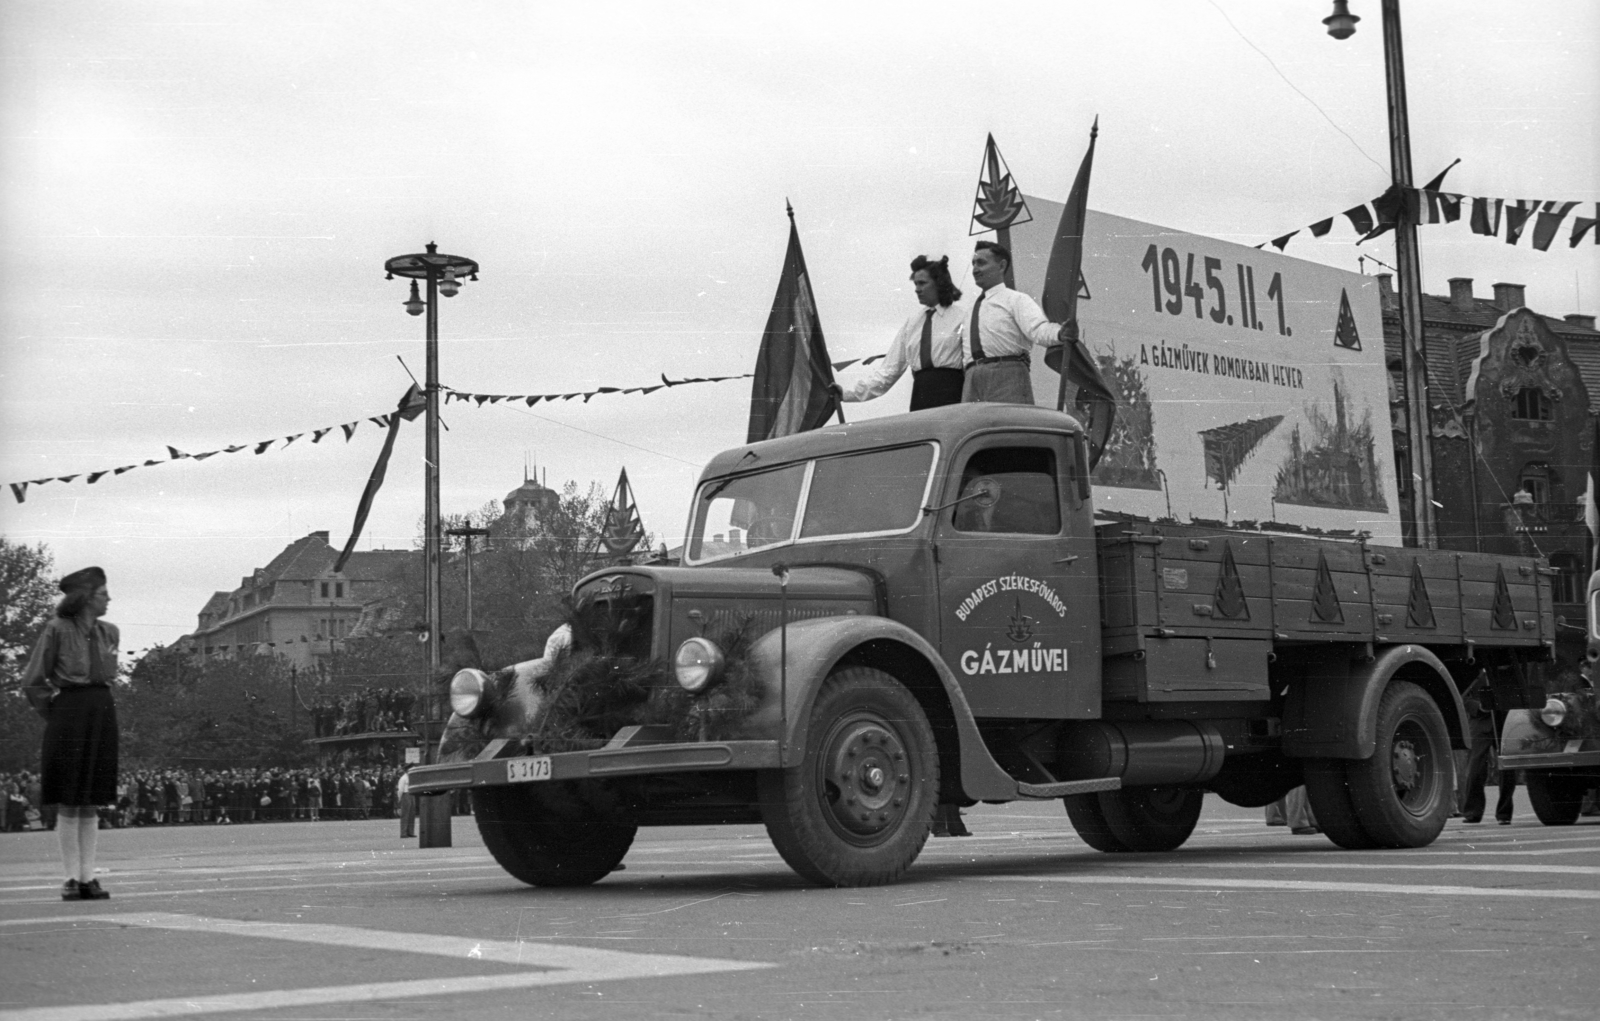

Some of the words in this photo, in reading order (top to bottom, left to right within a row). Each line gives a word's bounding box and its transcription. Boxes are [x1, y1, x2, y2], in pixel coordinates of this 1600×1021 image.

[1140, 343, 1149, 365] A
[1152, 339, 1209, 375] GÁZMŰVEK
[1213, 354, 1270, 383] ROMOKBAN
[1272, 364, 1304, 390] HEVER
[955, 579, 997, 622] BUDAPEST
[999, 571, 1067, 618] SZÉKESFŐVÁROS
[960, 642, 1068, 675] GÁZMŰVEI
[521, 760, 549, 777] 3173
